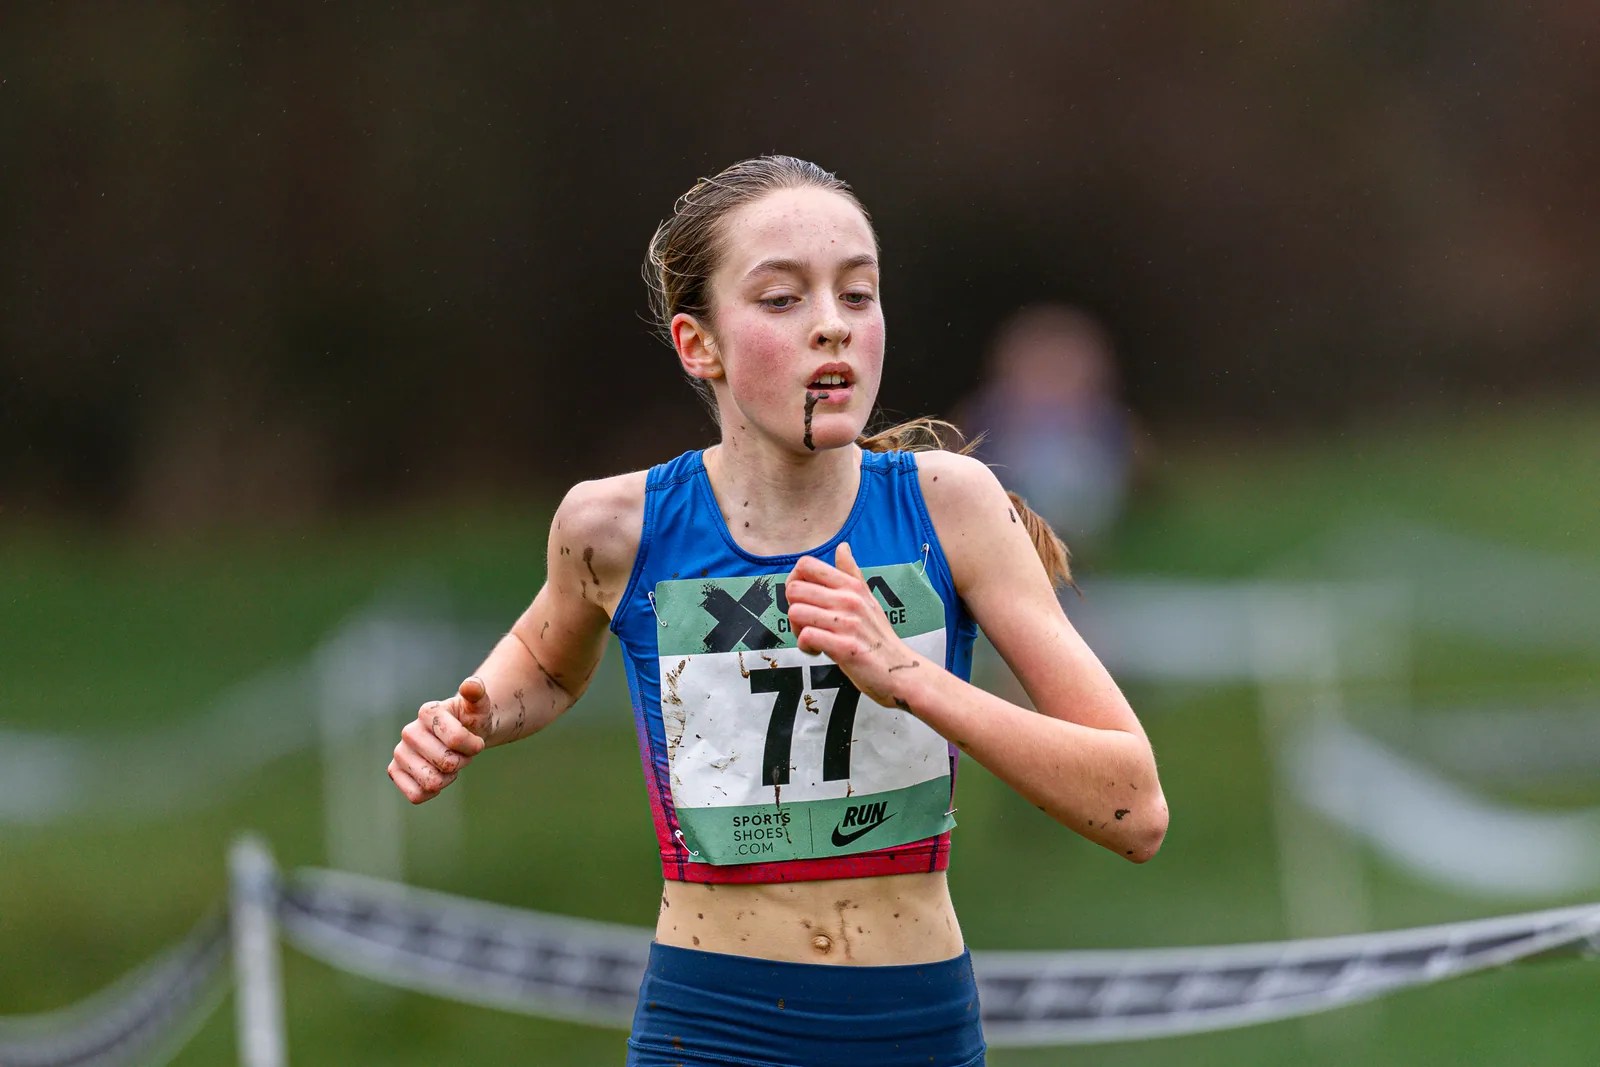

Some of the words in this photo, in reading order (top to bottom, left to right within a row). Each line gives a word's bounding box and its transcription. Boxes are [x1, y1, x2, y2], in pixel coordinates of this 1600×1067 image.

[749, 664, 862, 787] 77
[733, 812, 791, 828] SPORTS
[842, 801, 889, 828] RUN
[733, 827, 784, 842] SHOES
[735, 842, 774, 856] .COM
